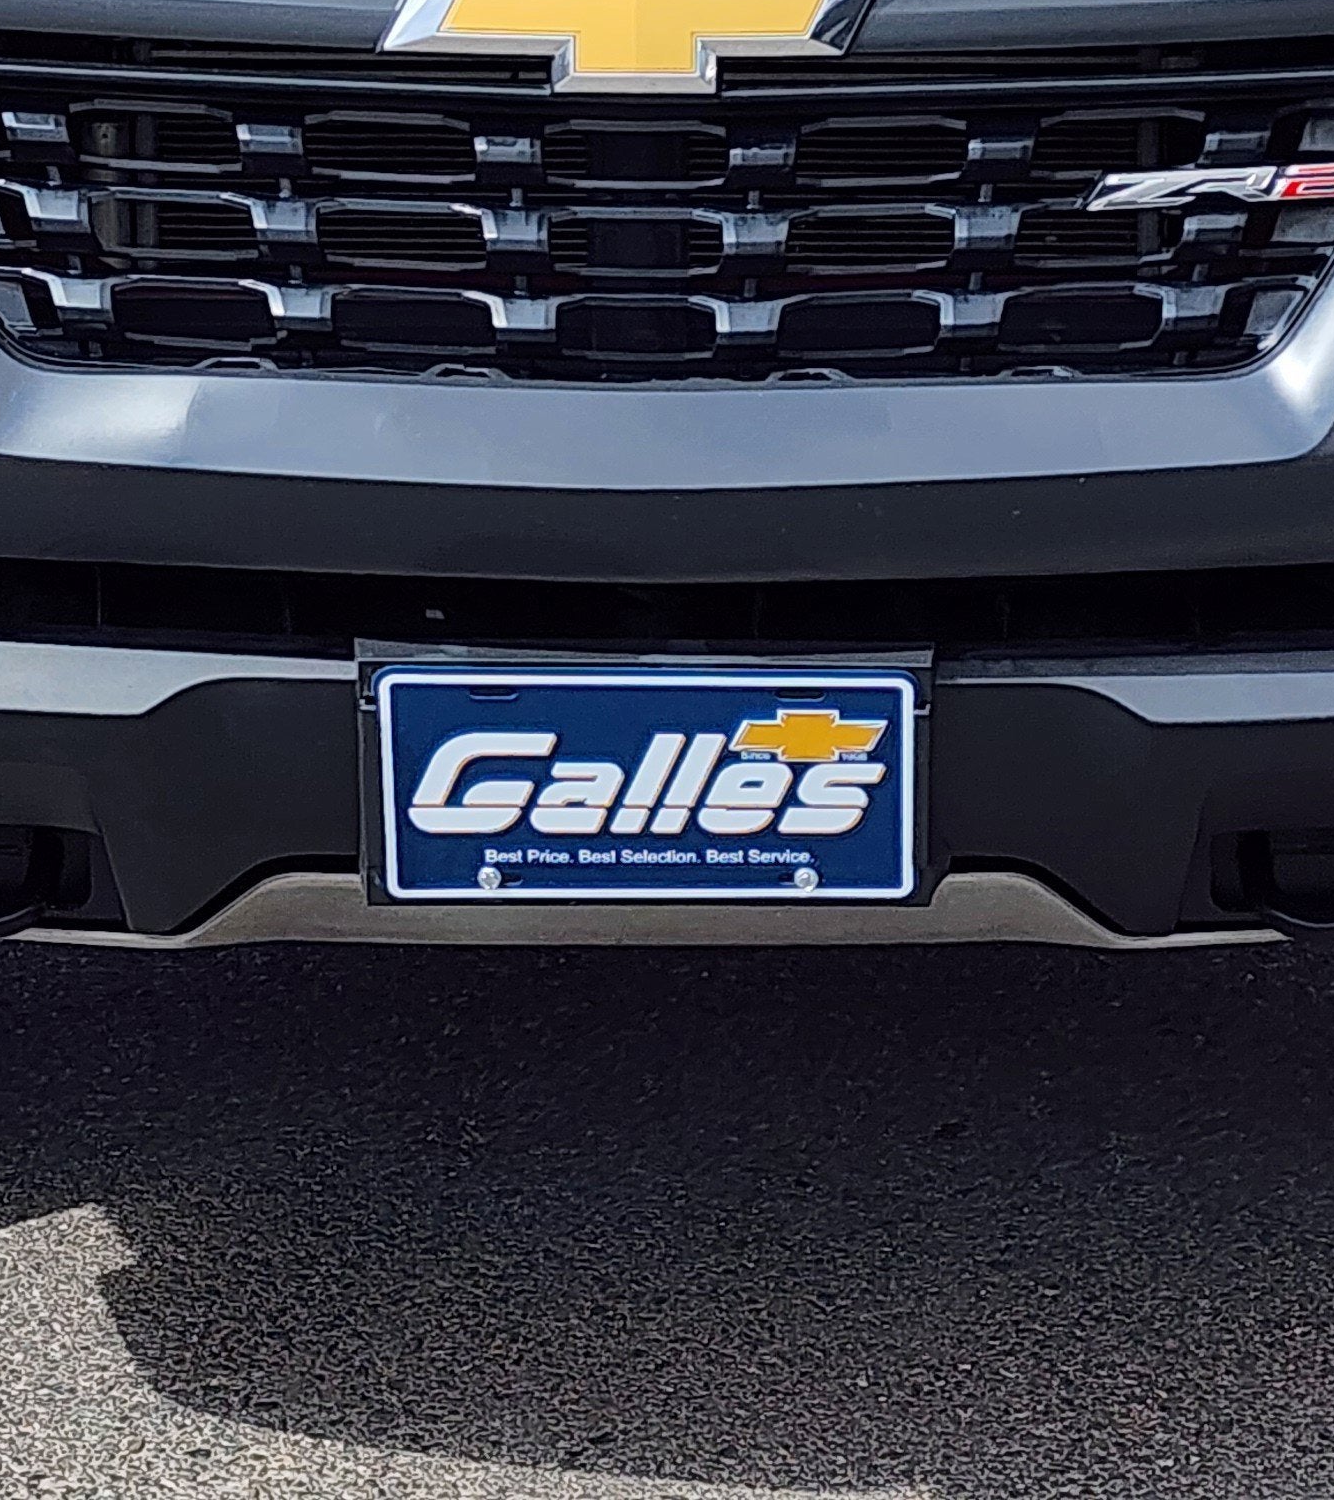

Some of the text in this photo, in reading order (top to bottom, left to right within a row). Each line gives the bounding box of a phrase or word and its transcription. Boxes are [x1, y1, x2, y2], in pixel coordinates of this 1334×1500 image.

[408, 732, 887, 834] Galles
[484, 848, 814, 864] Best Price. Best Selection. Best Service.
